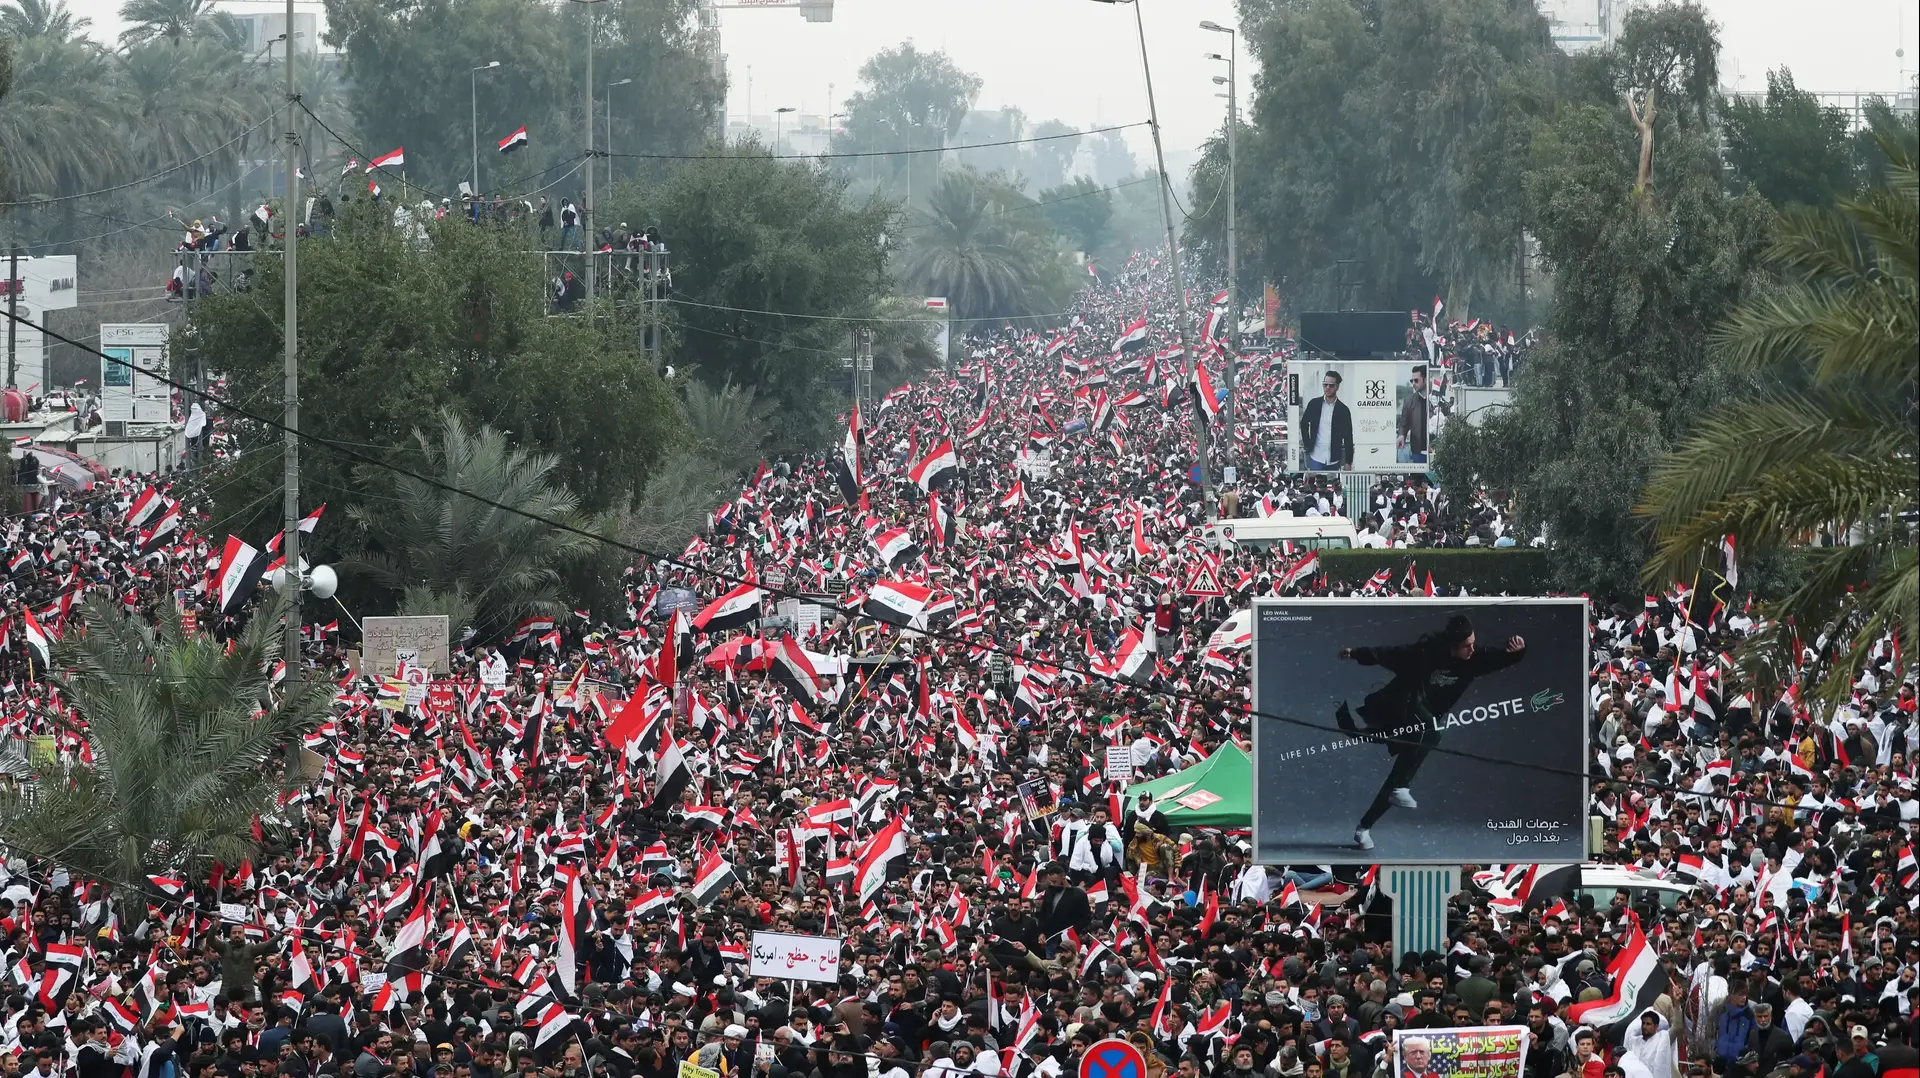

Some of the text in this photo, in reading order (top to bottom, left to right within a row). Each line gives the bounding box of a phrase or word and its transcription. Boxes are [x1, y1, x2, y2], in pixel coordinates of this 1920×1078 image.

[1433, 697, 1525, 731] LACOSTE
[1280, 749, 1302, 761] LIFE
[1306, 746, 1316, 756] IS
[1320, 744, 1328, 753] A
[1393, 722, 1426, 737] SPORT
[1487, 818, 1522, 830] الهندية
[1525, 818, 1559, 830] عرصات
[1506, 833, 1530, 845] مول
[1533, 832, 1560, 844] بغداد
[1263, 924, 1276, 932] BOY
[753, 945, 777, 965] امريكا
[819, 949, 837, 971] طاح
[1477, 1035, 1496, 1054] كلا
[1501, 1034, 1518, 1052] كلا
[683, 1064, 694, 1074] Hey
